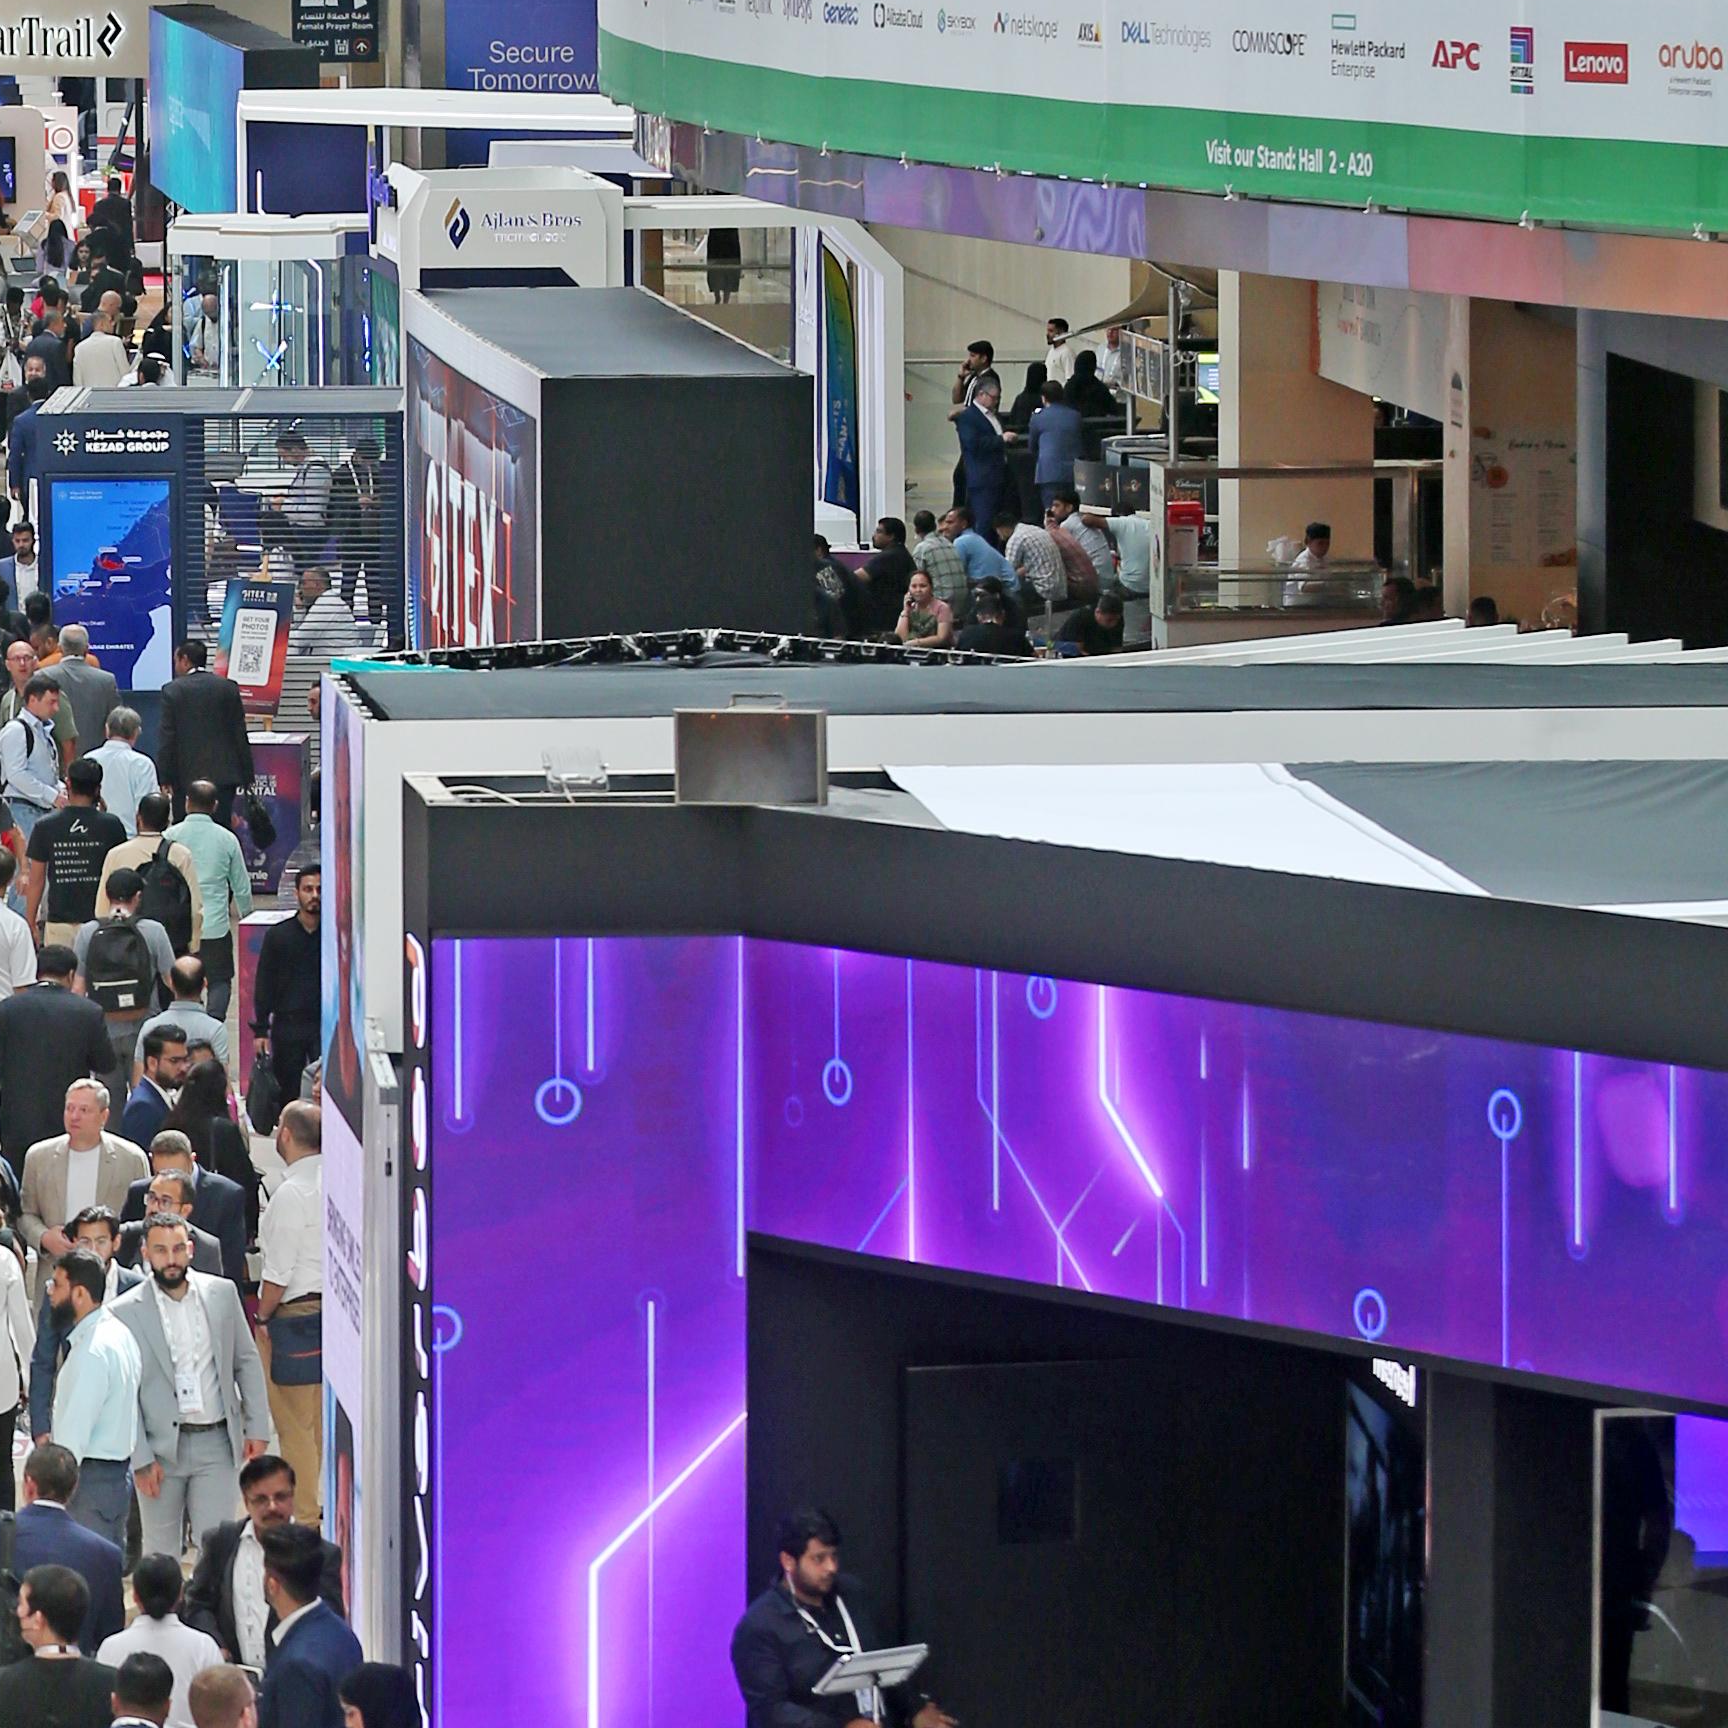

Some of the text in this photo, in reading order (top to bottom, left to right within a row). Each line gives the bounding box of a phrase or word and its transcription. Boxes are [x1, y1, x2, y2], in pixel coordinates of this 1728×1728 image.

[297, 21, 374, 32] Female Prayer Room
[822, 1, 860, 26] Genetec
[1010, 16, 1059, 43] netskope
[1077, 22, 1095, 44] AXIS
[1121, 20, 1150, 45] DELL
[1150, 21, 1212, 50] Technologies
[1232, 29, 1308, 57] COMMSCOPE
[488, 39, 575, 64] Secure
[1330, 38, 1406, 60] Hewlett Packard
[1431, 39, 1724, 76] APC Lenovo aruba
[467, 68, 596, 90] Tomorrow
[1330, 59, 1376, 81] Enterprise
[1205, 139, 1374, 177] Visit our Stand: Hall 2 A20
[480, 212, 524, 230] Ajlan
[542, 212, 583, 227] Bros
[84, 440, 171, 454] KEZAD GROUP
[425, 459, 498, 648] GITEX
